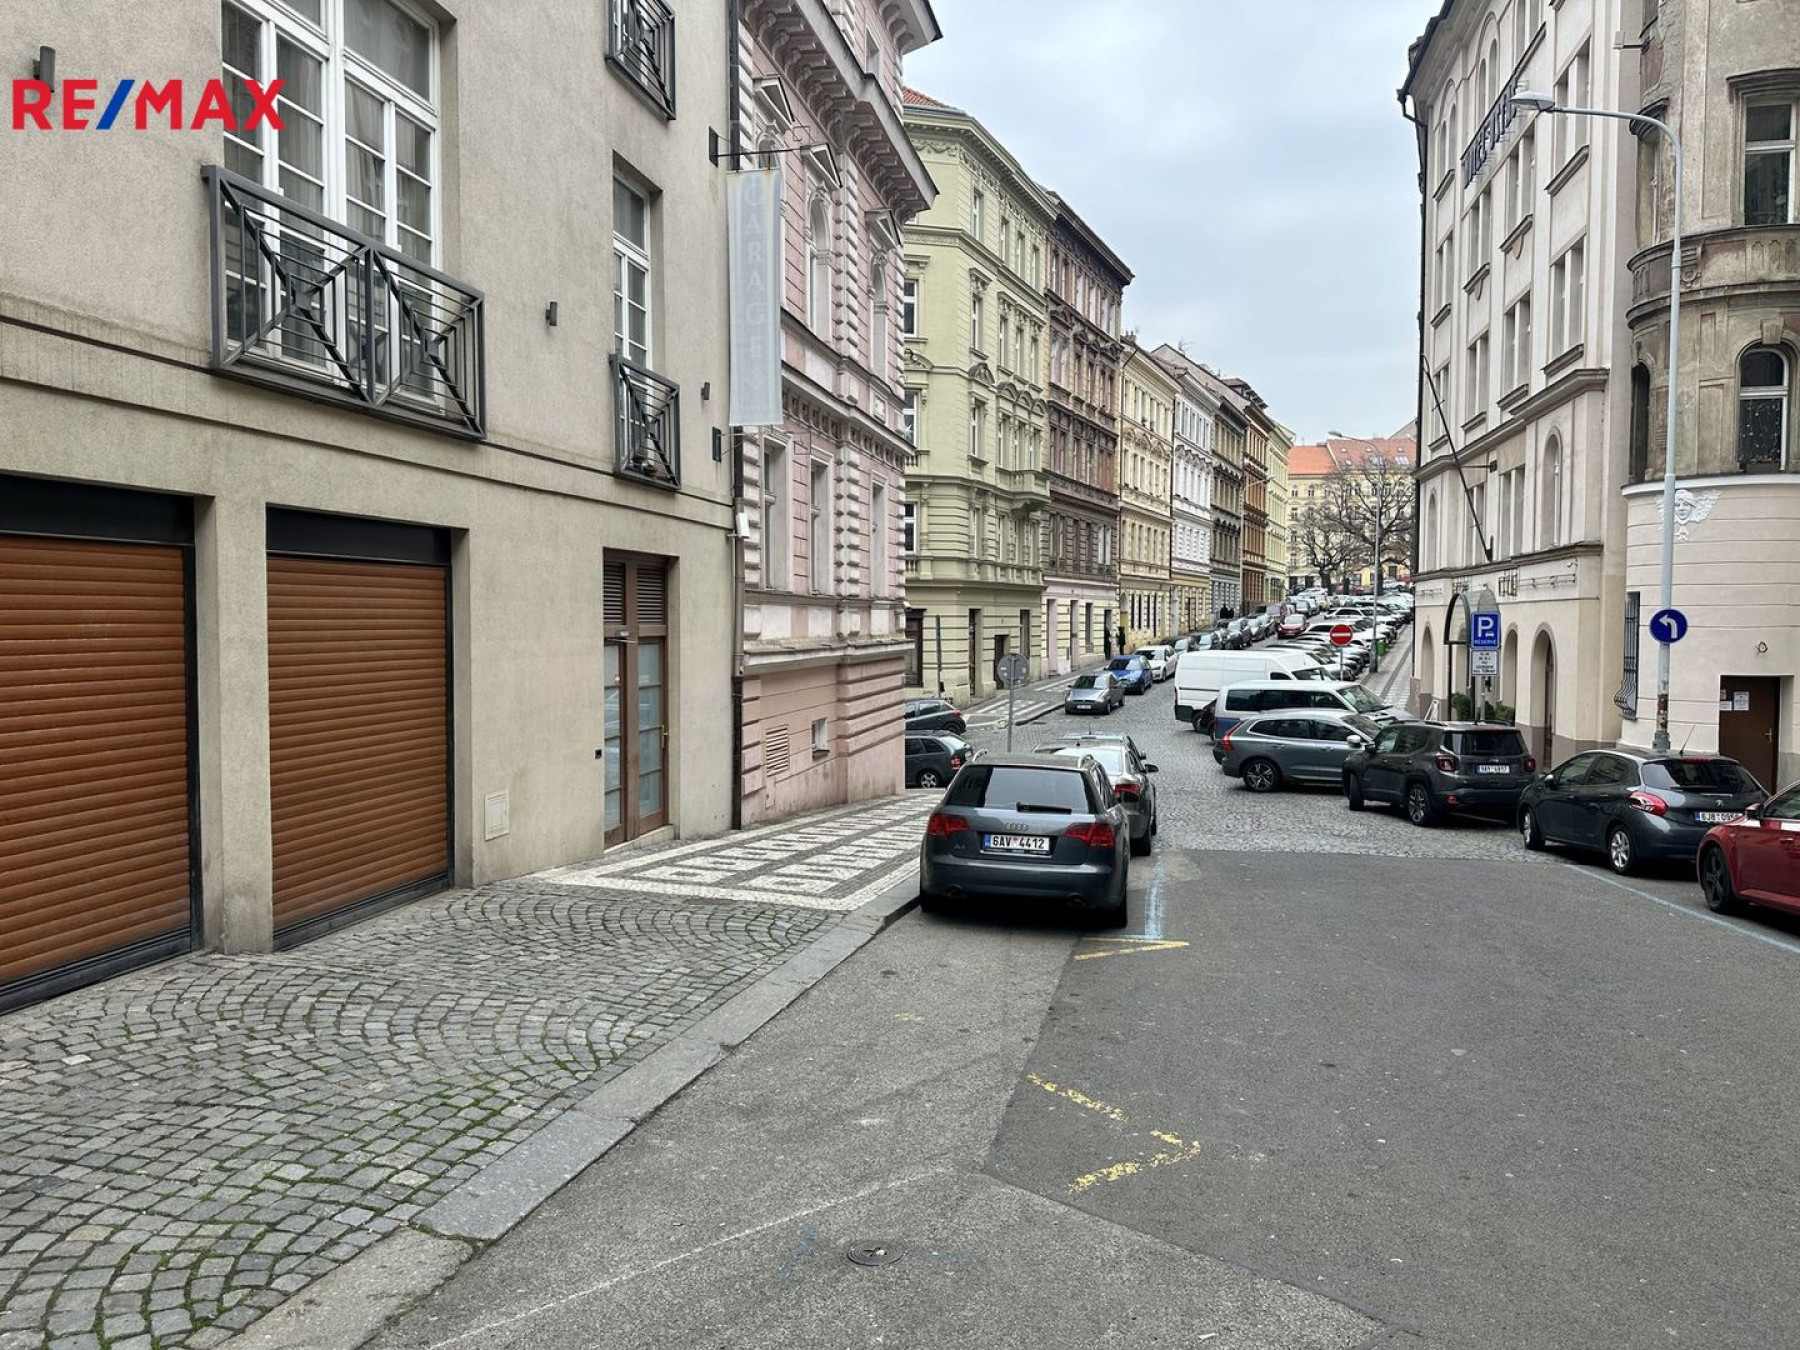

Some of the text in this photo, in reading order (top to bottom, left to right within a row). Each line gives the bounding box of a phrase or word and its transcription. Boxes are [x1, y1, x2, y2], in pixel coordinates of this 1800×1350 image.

[1478, 616, 1494, 638] P
[993, 835, 1045, 850] 6AV 4412
